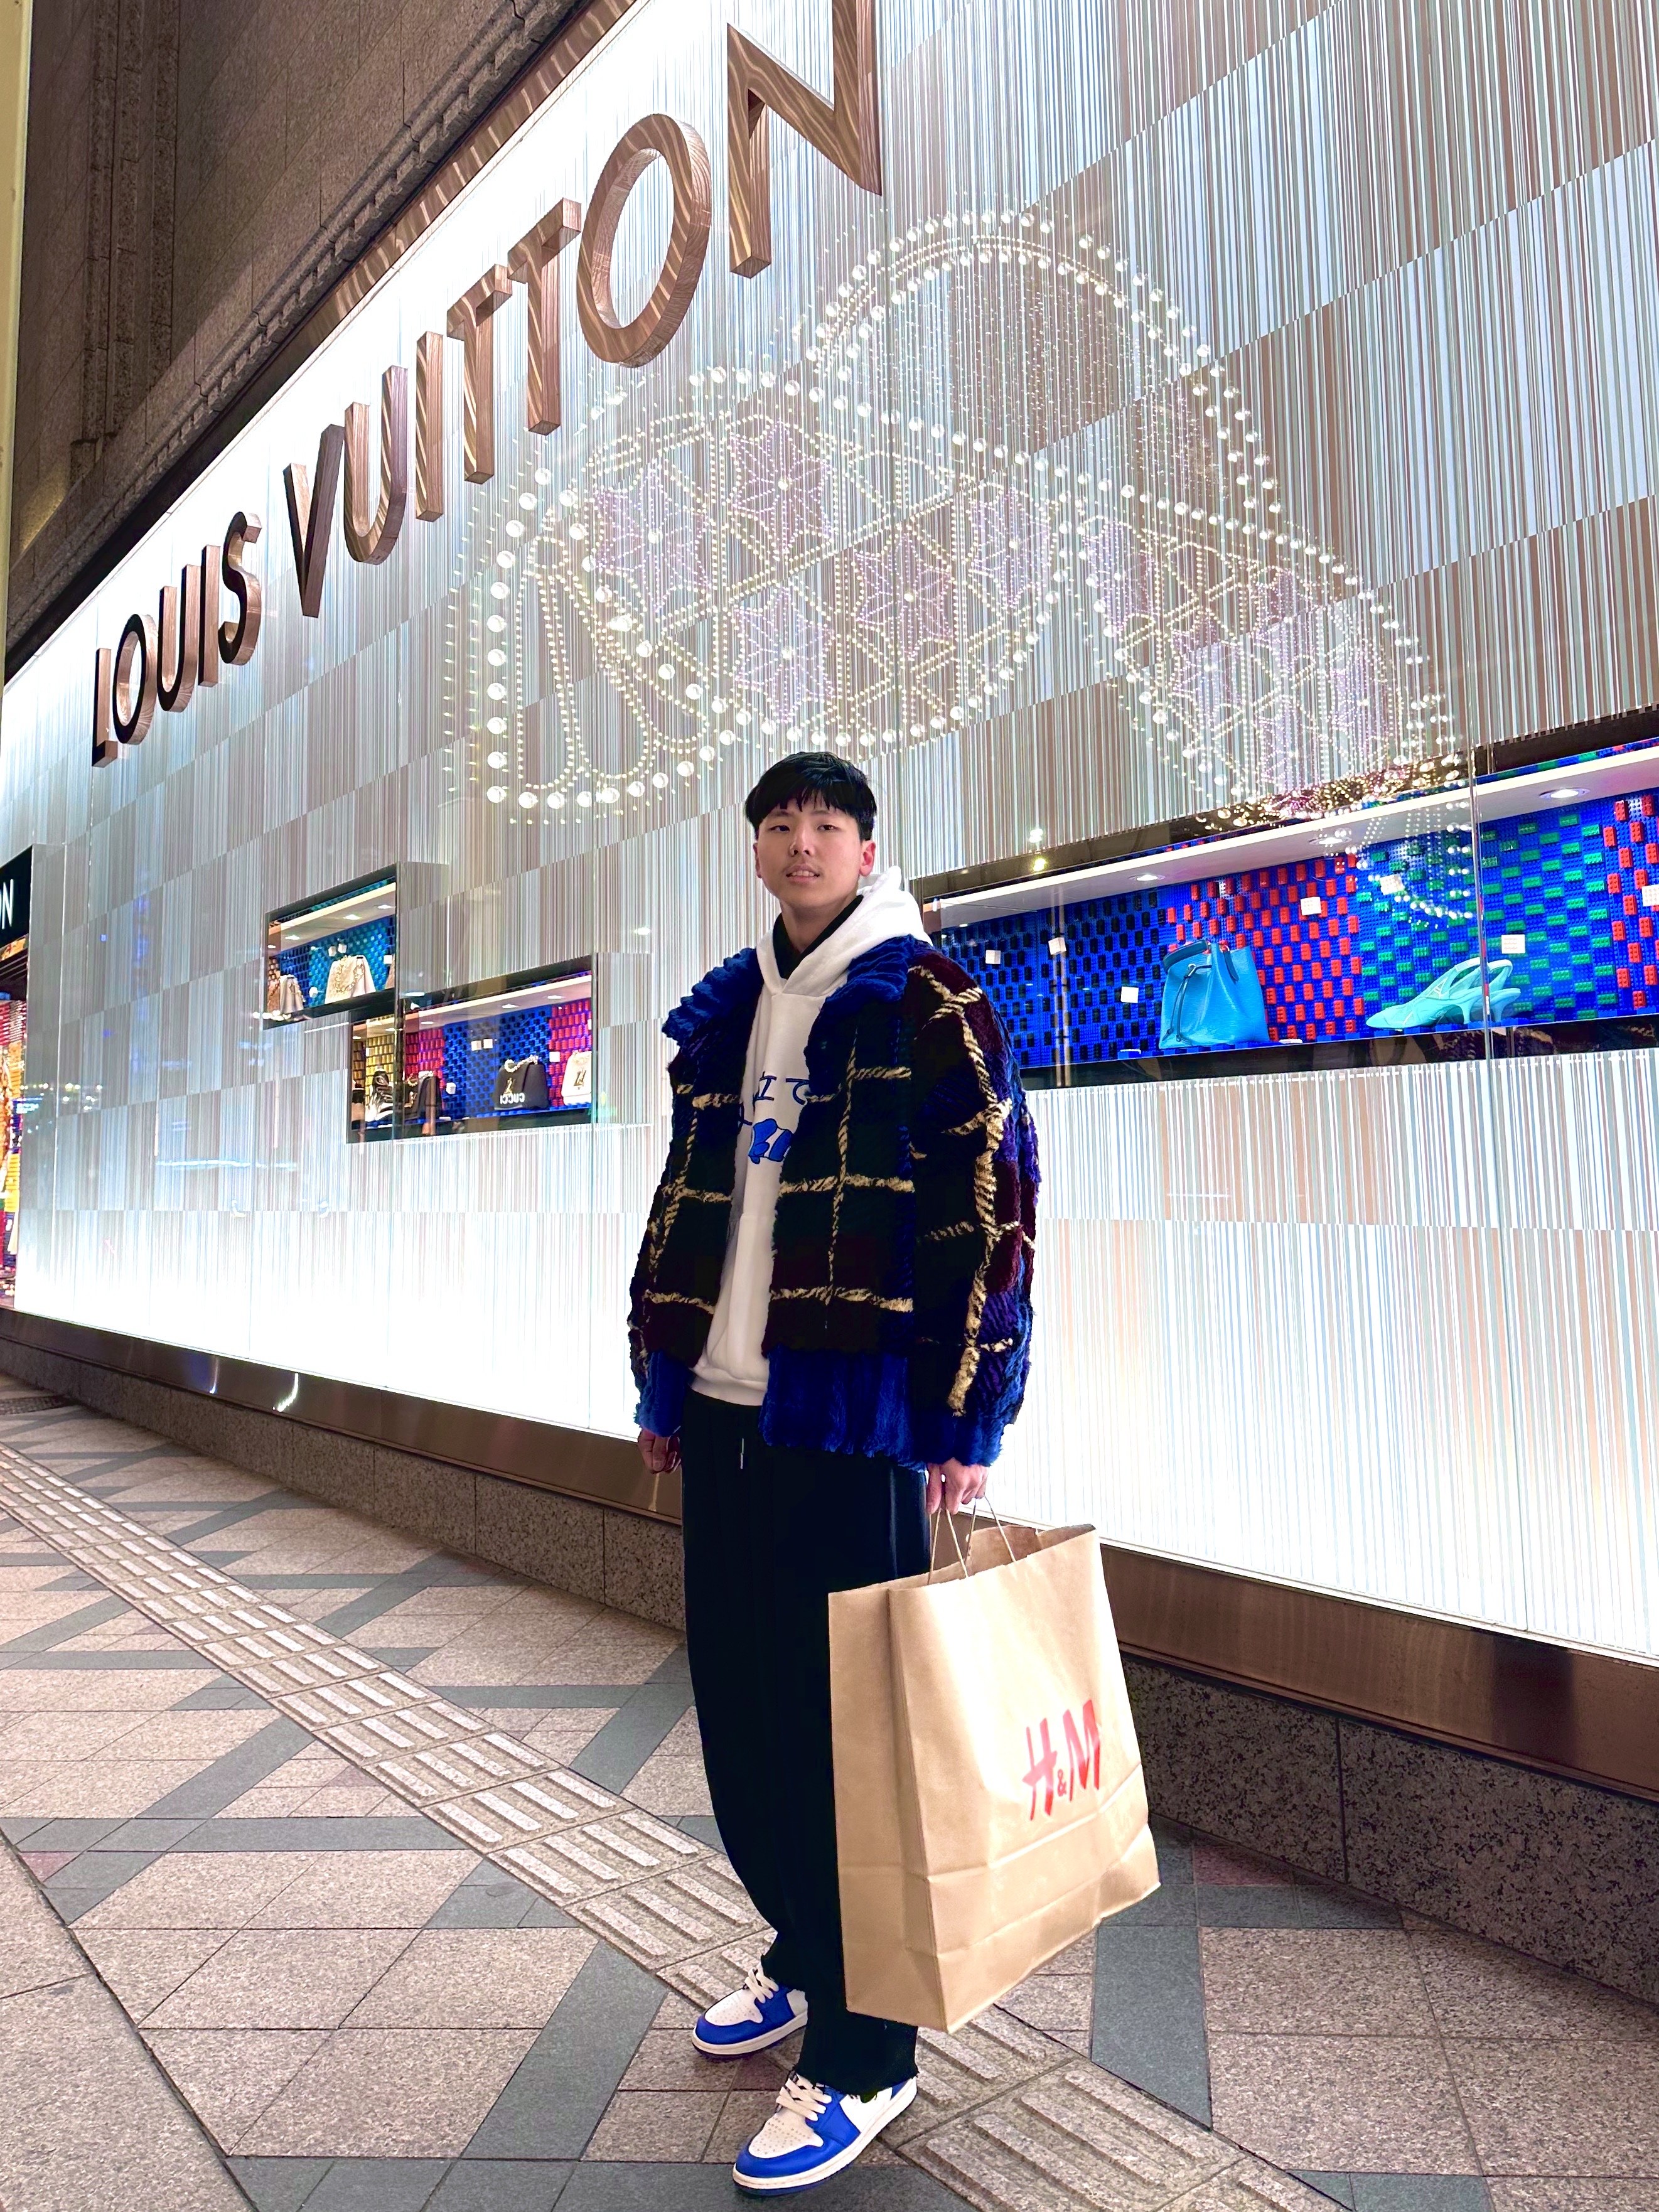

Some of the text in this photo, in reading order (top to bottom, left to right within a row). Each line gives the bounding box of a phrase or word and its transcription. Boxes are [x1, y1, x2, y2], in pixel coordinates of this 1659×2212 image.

[92, 0, 883, 768] LOUIS VUITTON
[1023, 1699, 1100, 1821] H&M
